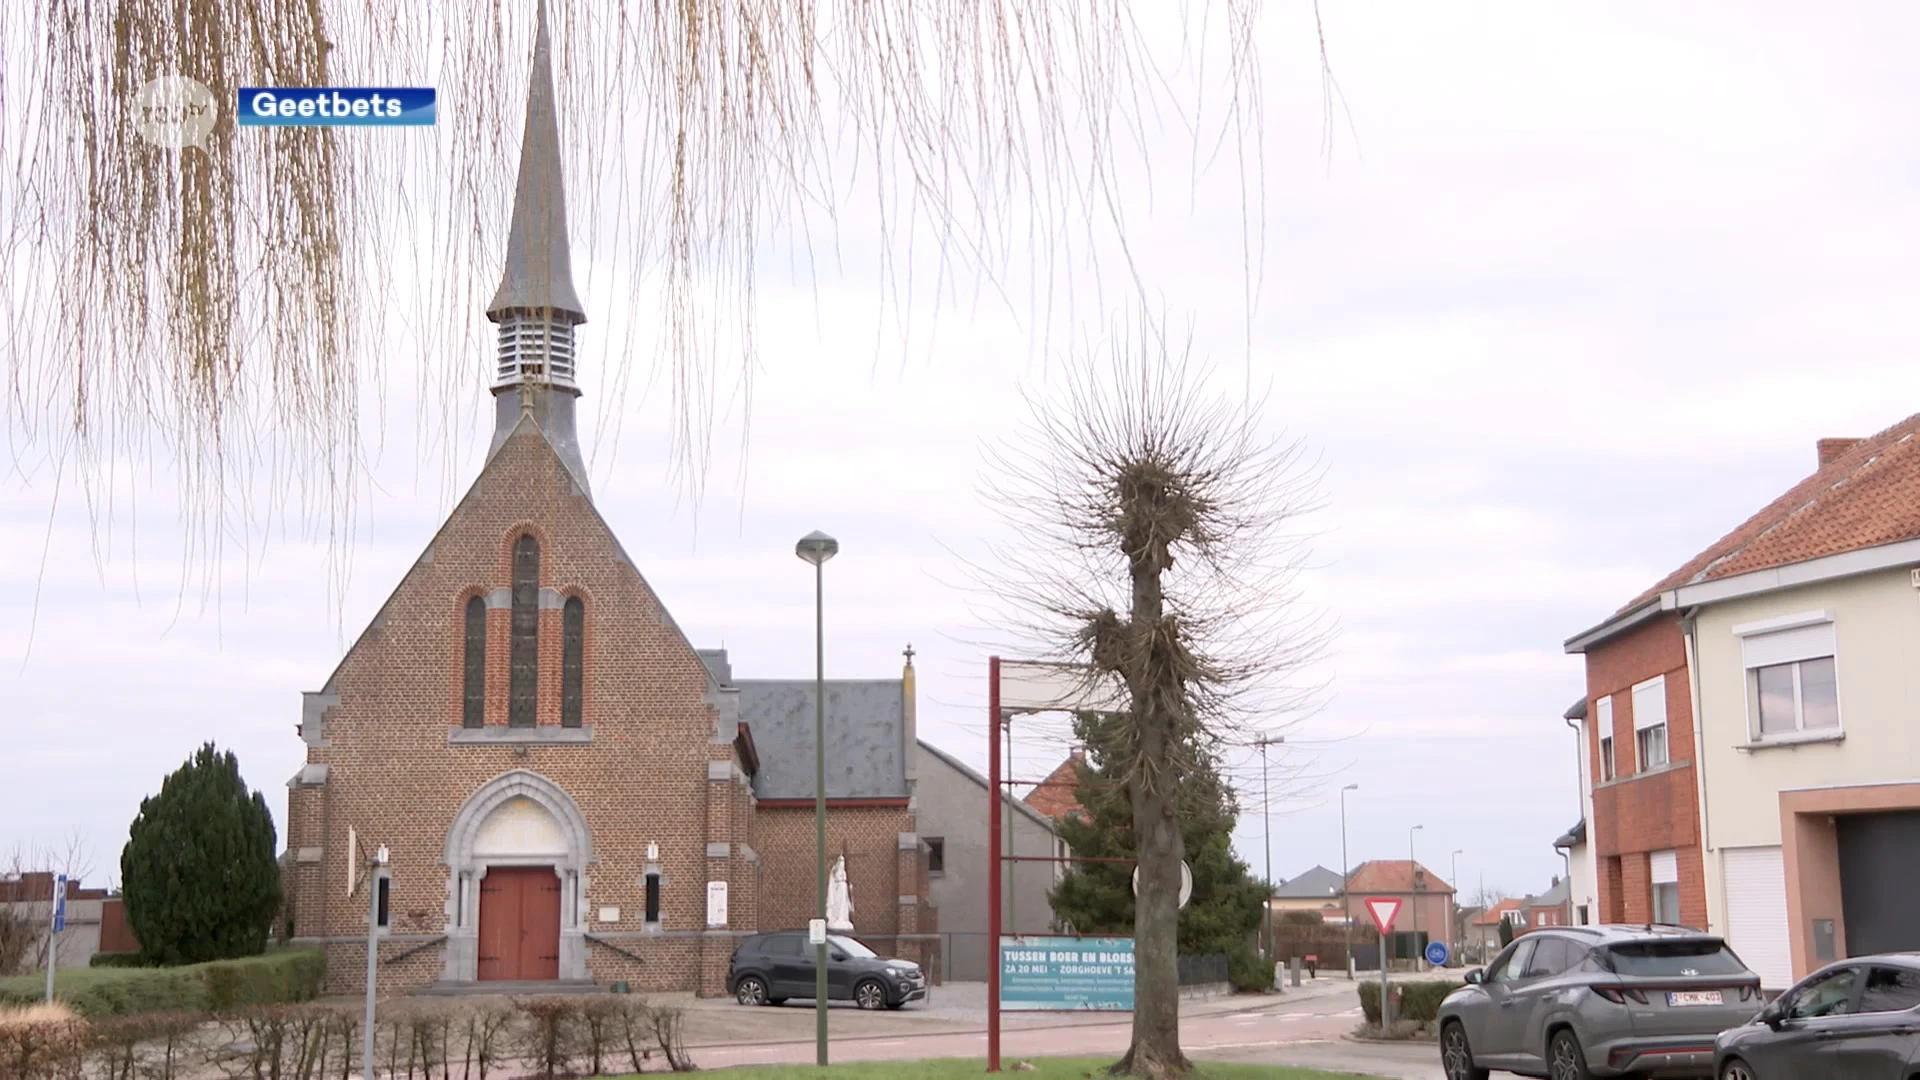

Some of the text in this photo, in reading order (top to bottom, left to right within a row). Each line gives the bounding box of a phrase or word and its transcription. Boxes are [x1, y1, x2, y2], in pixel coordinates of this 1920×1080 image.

[1004, 952, 1046, 962] TUSSEN
[1049, 951, 1079, 962] BOER
[1082, 952, 1096, 962] EN
[1005, 965, 1016, 974] ZA
[1018, 965, 1030, 974] 20
[1031, 965, 1048, 974] MEI
[1060, 965, 1112, 975] ZORGHOEVE
